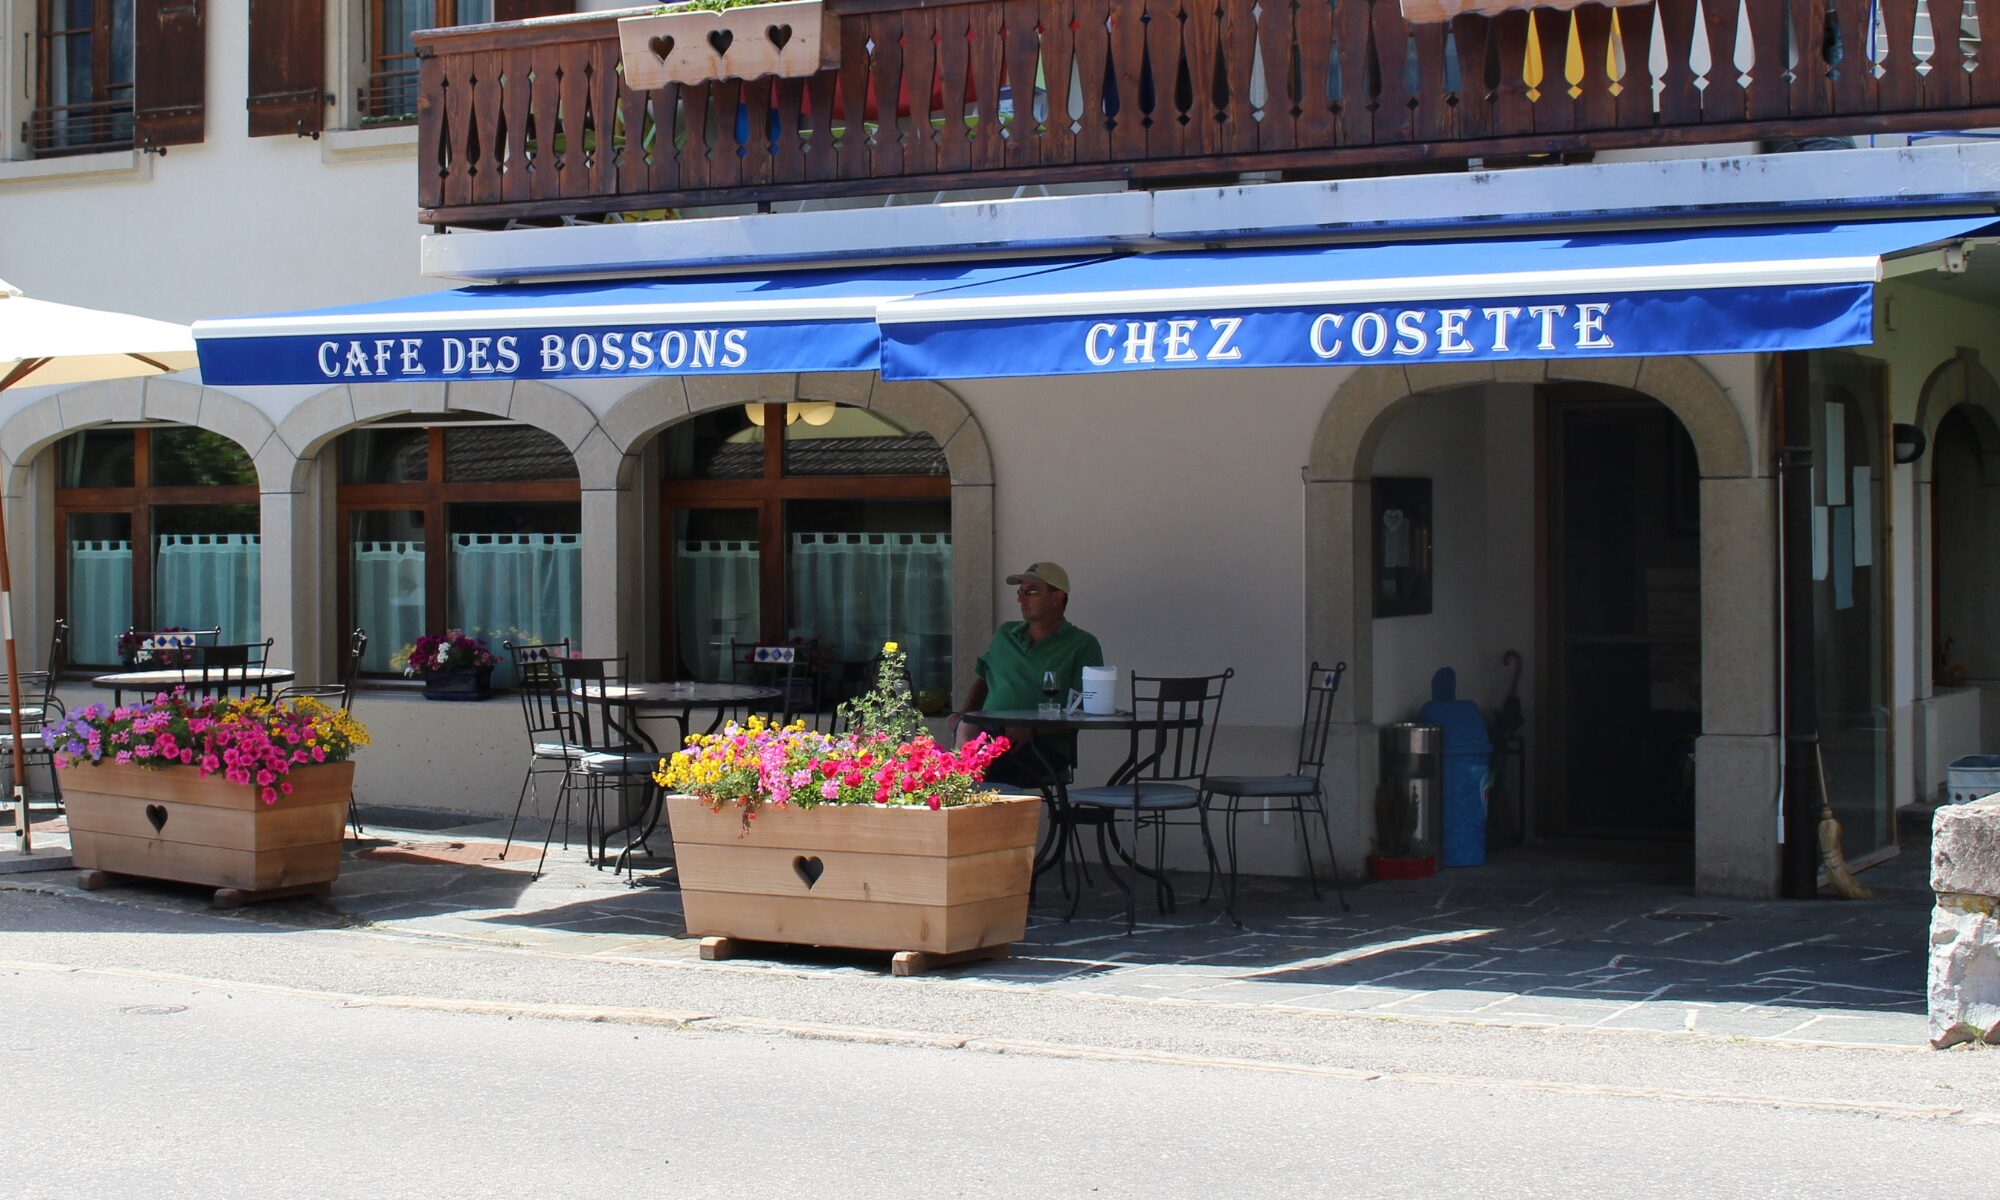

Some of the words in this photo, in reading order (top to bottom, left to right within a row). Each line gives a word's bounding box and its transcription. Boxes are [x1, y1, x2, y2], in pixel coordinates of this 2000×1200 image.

[316, 336, 426, 379] CAFE
[442, 334, 521, 375] DES
[540, 327, 749, 373] BOSSONS
[1084, 316, 1243, 369] CHEZ
[1309, 301, 1616, 361] COSETTE
